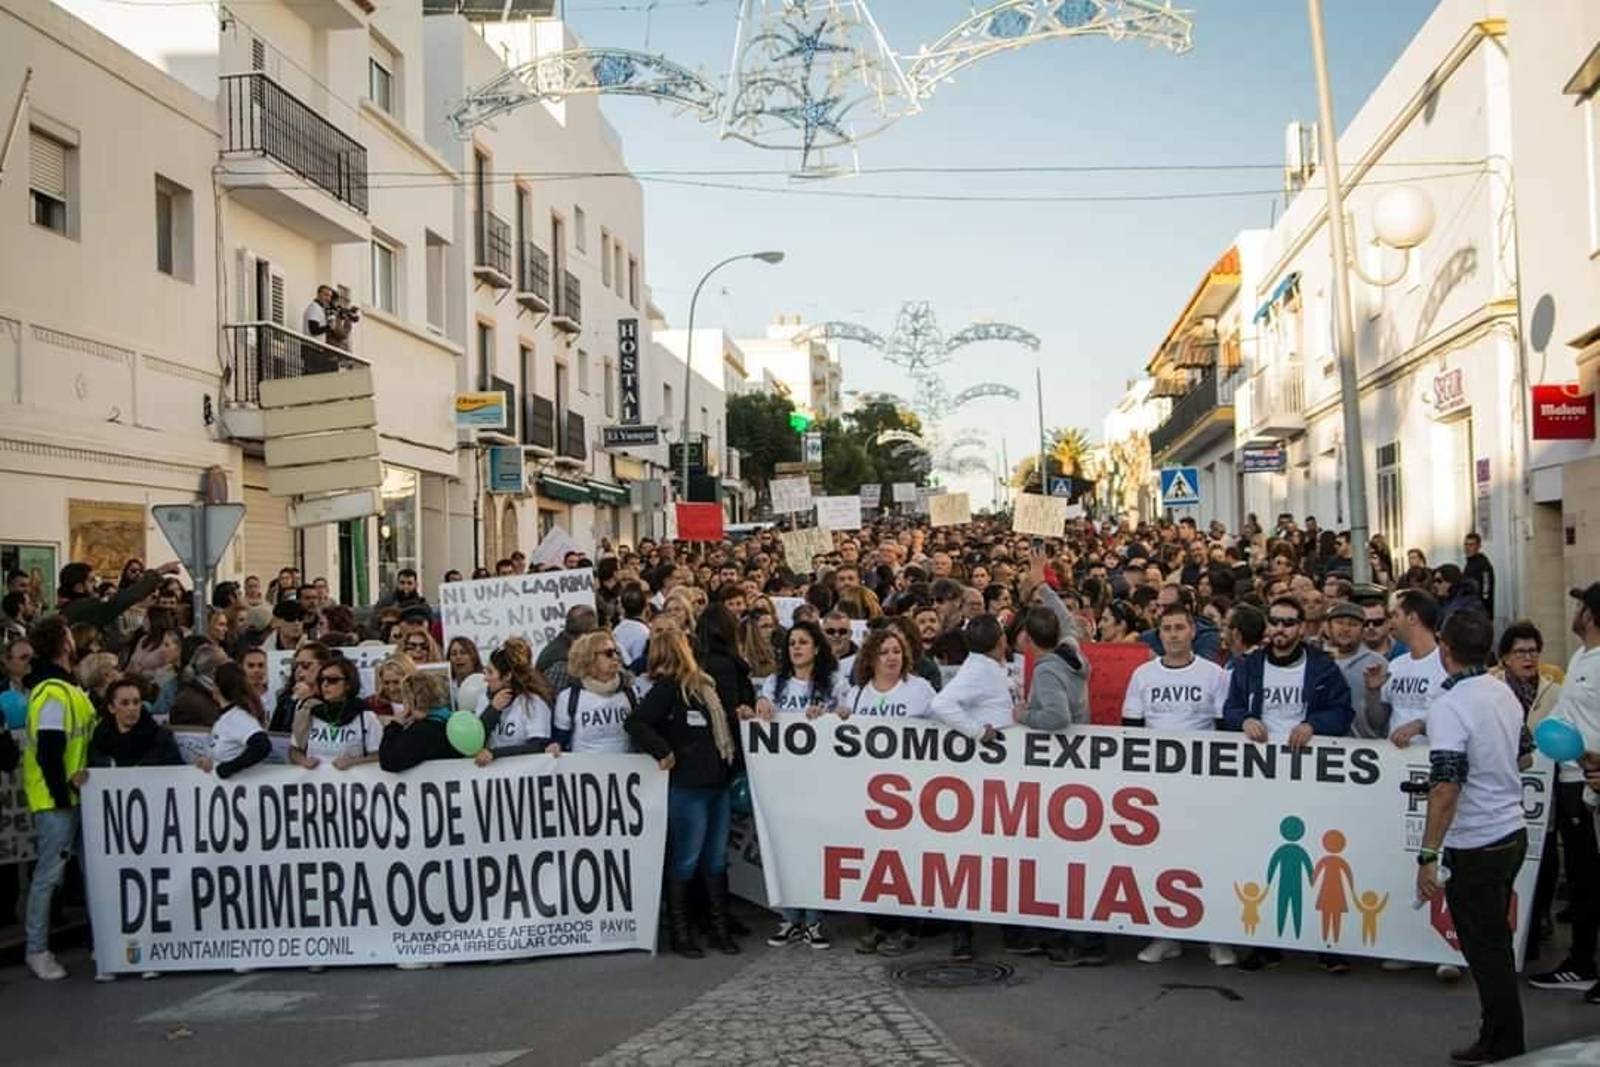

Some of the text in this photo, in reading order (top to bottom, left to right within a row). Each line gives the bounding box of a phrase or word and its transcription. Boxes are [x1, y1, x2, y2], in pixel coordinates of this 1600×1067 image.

[621, 323, 637, 420] HOSTAL
[1540, 402, 1587, 416] Mahou
[474, 580, 519, 600] UNA
[508, 605, 533, 626] NI
[1151, 687, 1202, 703] PAVIC
[1263, 687, 1305, 704] PAVI
[748, 721, 1381, 785] NO SOMOS EXPEDIENTES
[103, 787, 148, 855] NO
[162, 787, 182, 854] A
[194, 783, 248, 855] LOS
[259, 779, 410, 853] DERRIBOS
[422, 779, 465, 847] DE
[472, 771, 643, 844] VIVIENDAS
[865, 774, 1160, 846] SOMOS
[119, 847, 633, 935] DE PRIMERA OCUPACION
[823, 845, 1204, 929] FAMILIAS
[393, 927, 485, 943] PLATAFORMA
[487, 926, 506, 940] DE
[510, 920, 593, 938] AFECTADOS
[600, 918, 637, 933] PAVIC
[150, 936, 354, 961] AYUNTAMIENTO DE CONIL
[396, 941, 462, 956] VIVIENDA
[464, 937, 545, 953] IRREGULAR
[549, 932, 592, 947] CONIL
